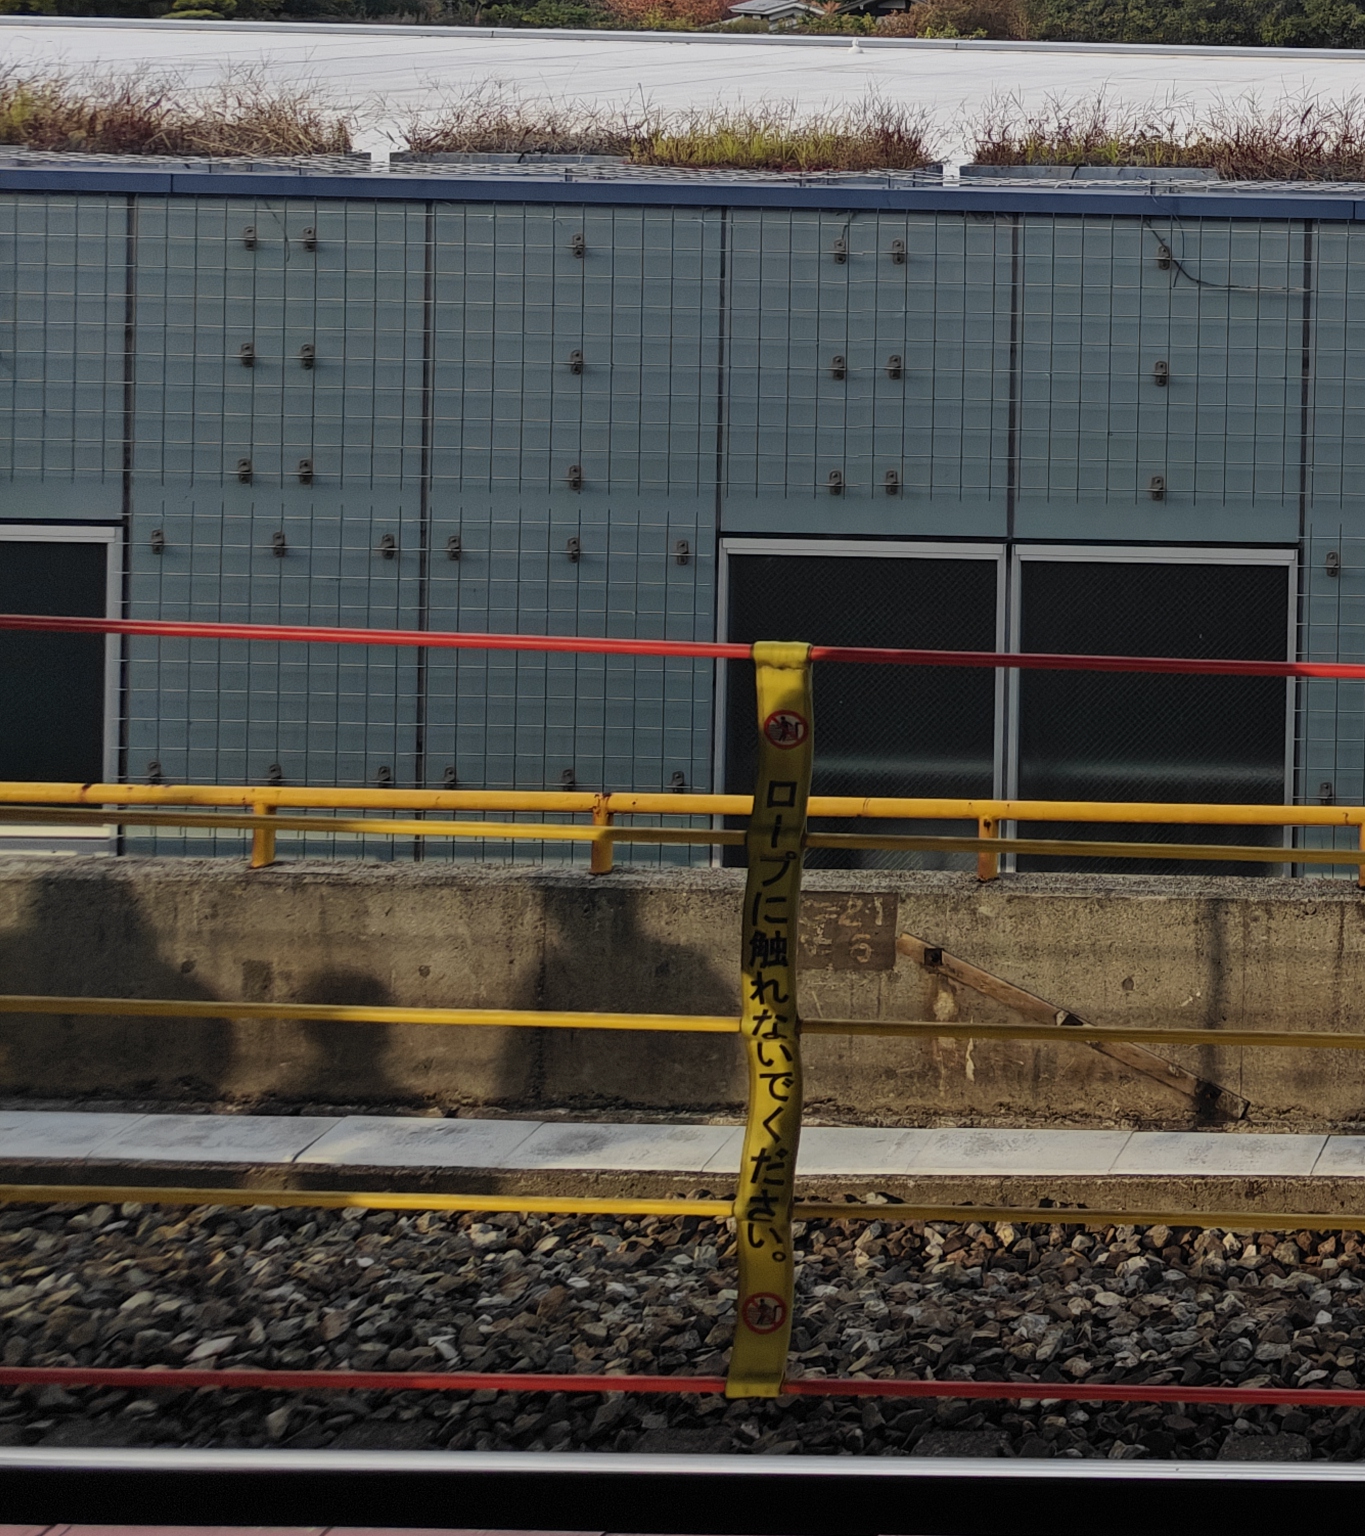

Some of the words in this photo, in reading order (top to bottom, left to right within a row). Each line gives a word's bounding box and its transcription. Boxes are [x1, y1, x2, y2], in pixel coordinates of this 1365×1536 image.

[747, 780, 798, 1262] ロープに触れないでください。
